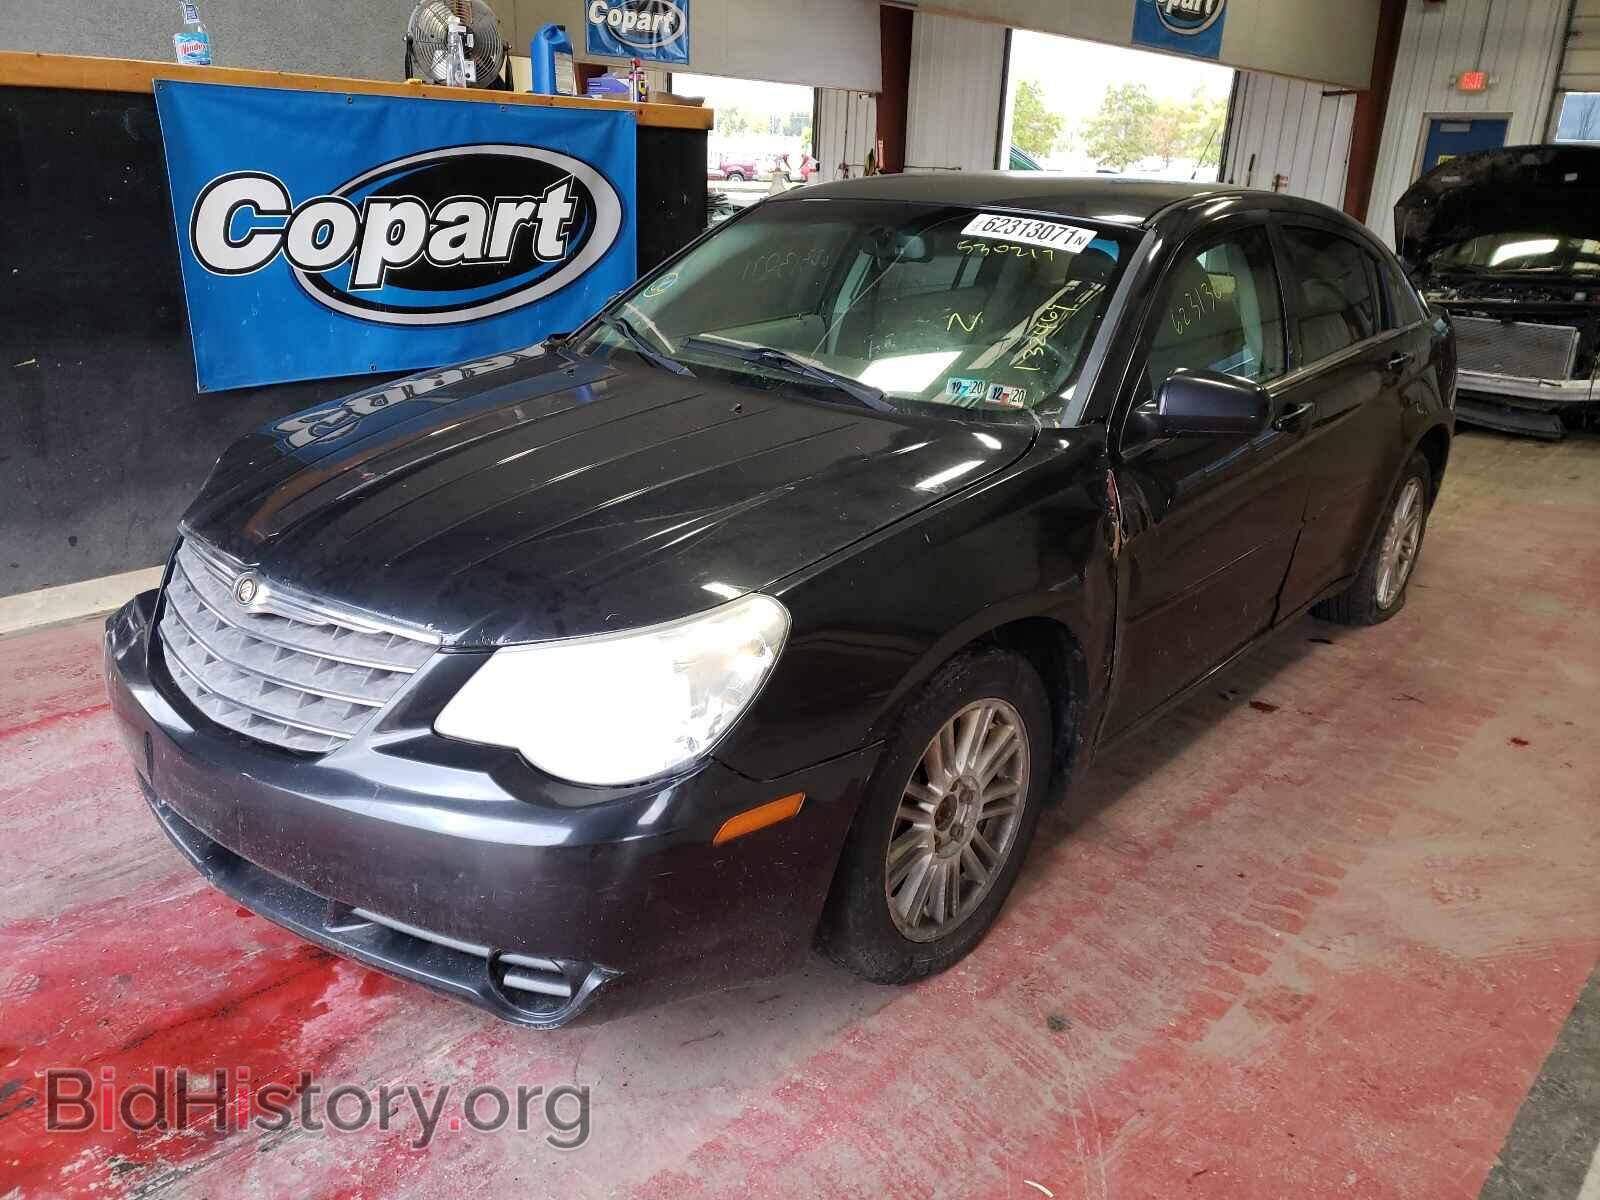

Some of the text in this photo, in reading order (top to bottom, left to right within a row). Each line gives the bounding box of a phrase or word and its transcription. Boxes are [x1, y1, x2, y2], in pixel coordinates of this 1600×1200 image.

[589, 0, 673, 34] Copart
[189, 171, 577, 292] Copart
[982, 216, 1080, 245] 62313071
[1074, 236, 1086, 246] N
